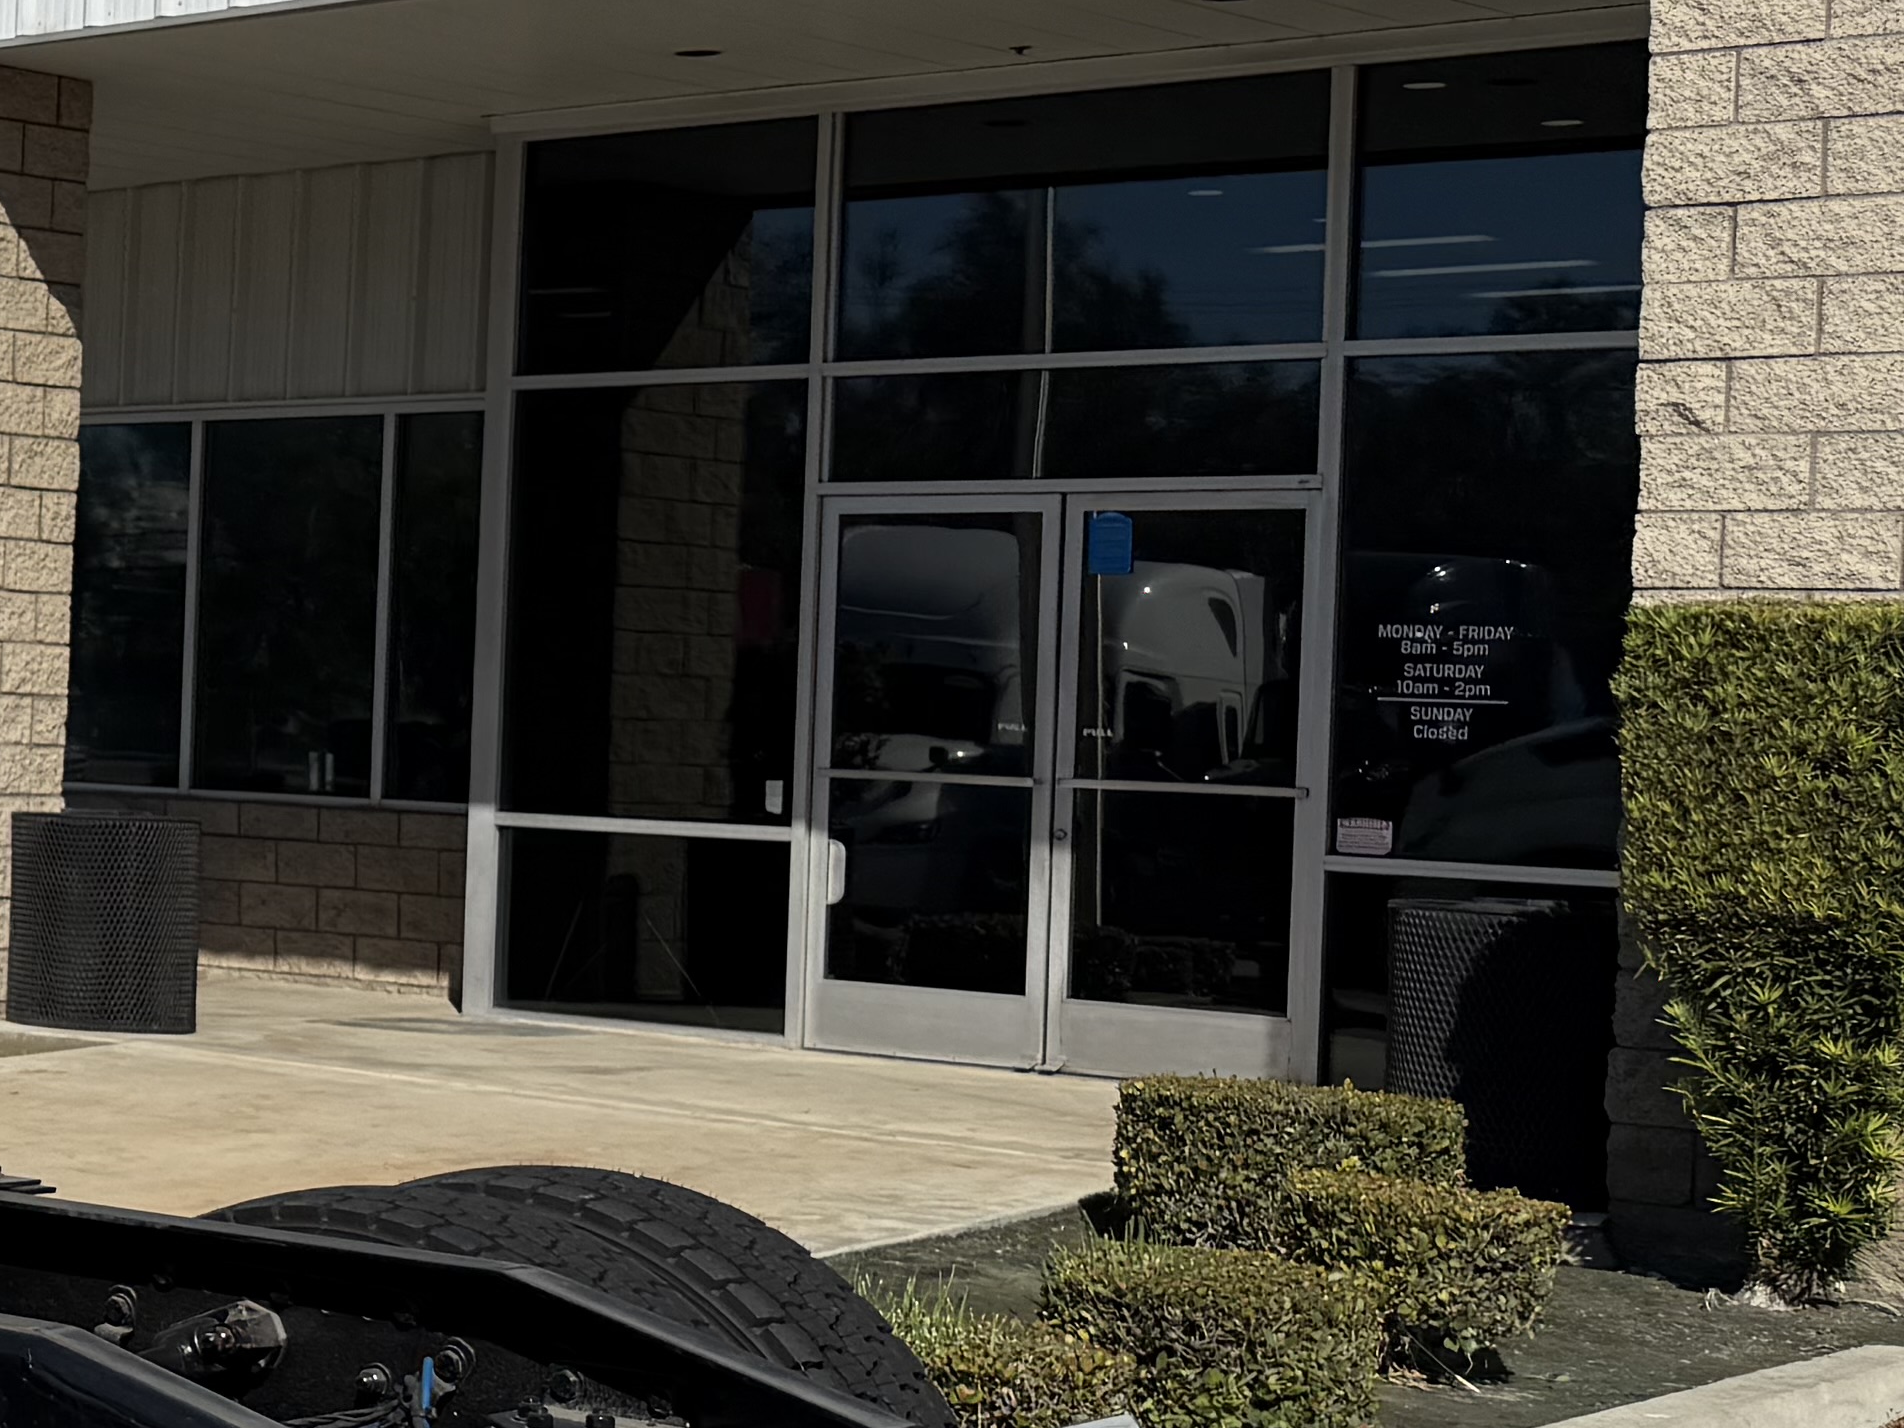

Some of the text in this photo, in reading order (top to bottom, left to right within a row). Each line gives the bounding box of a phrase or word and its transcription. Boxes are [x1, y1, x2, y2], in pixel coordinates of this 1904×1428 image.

[1378, 624, 1443, 639] MONDAY
[1459, 625, 1514, 640] FRIDAY
[1400, 640, 1436, 654] 8am
[1452, 641, 1489, 657] 5pm
[1403, 663, 1485, 679] SATURDAY
[1396, 679, 1439, 694] 10am
[1454, 681, 1491, 698] 2pm
[1410, 706, 1473, 721] SUNDAY
[1413, 725, 1469, 740] Closed
